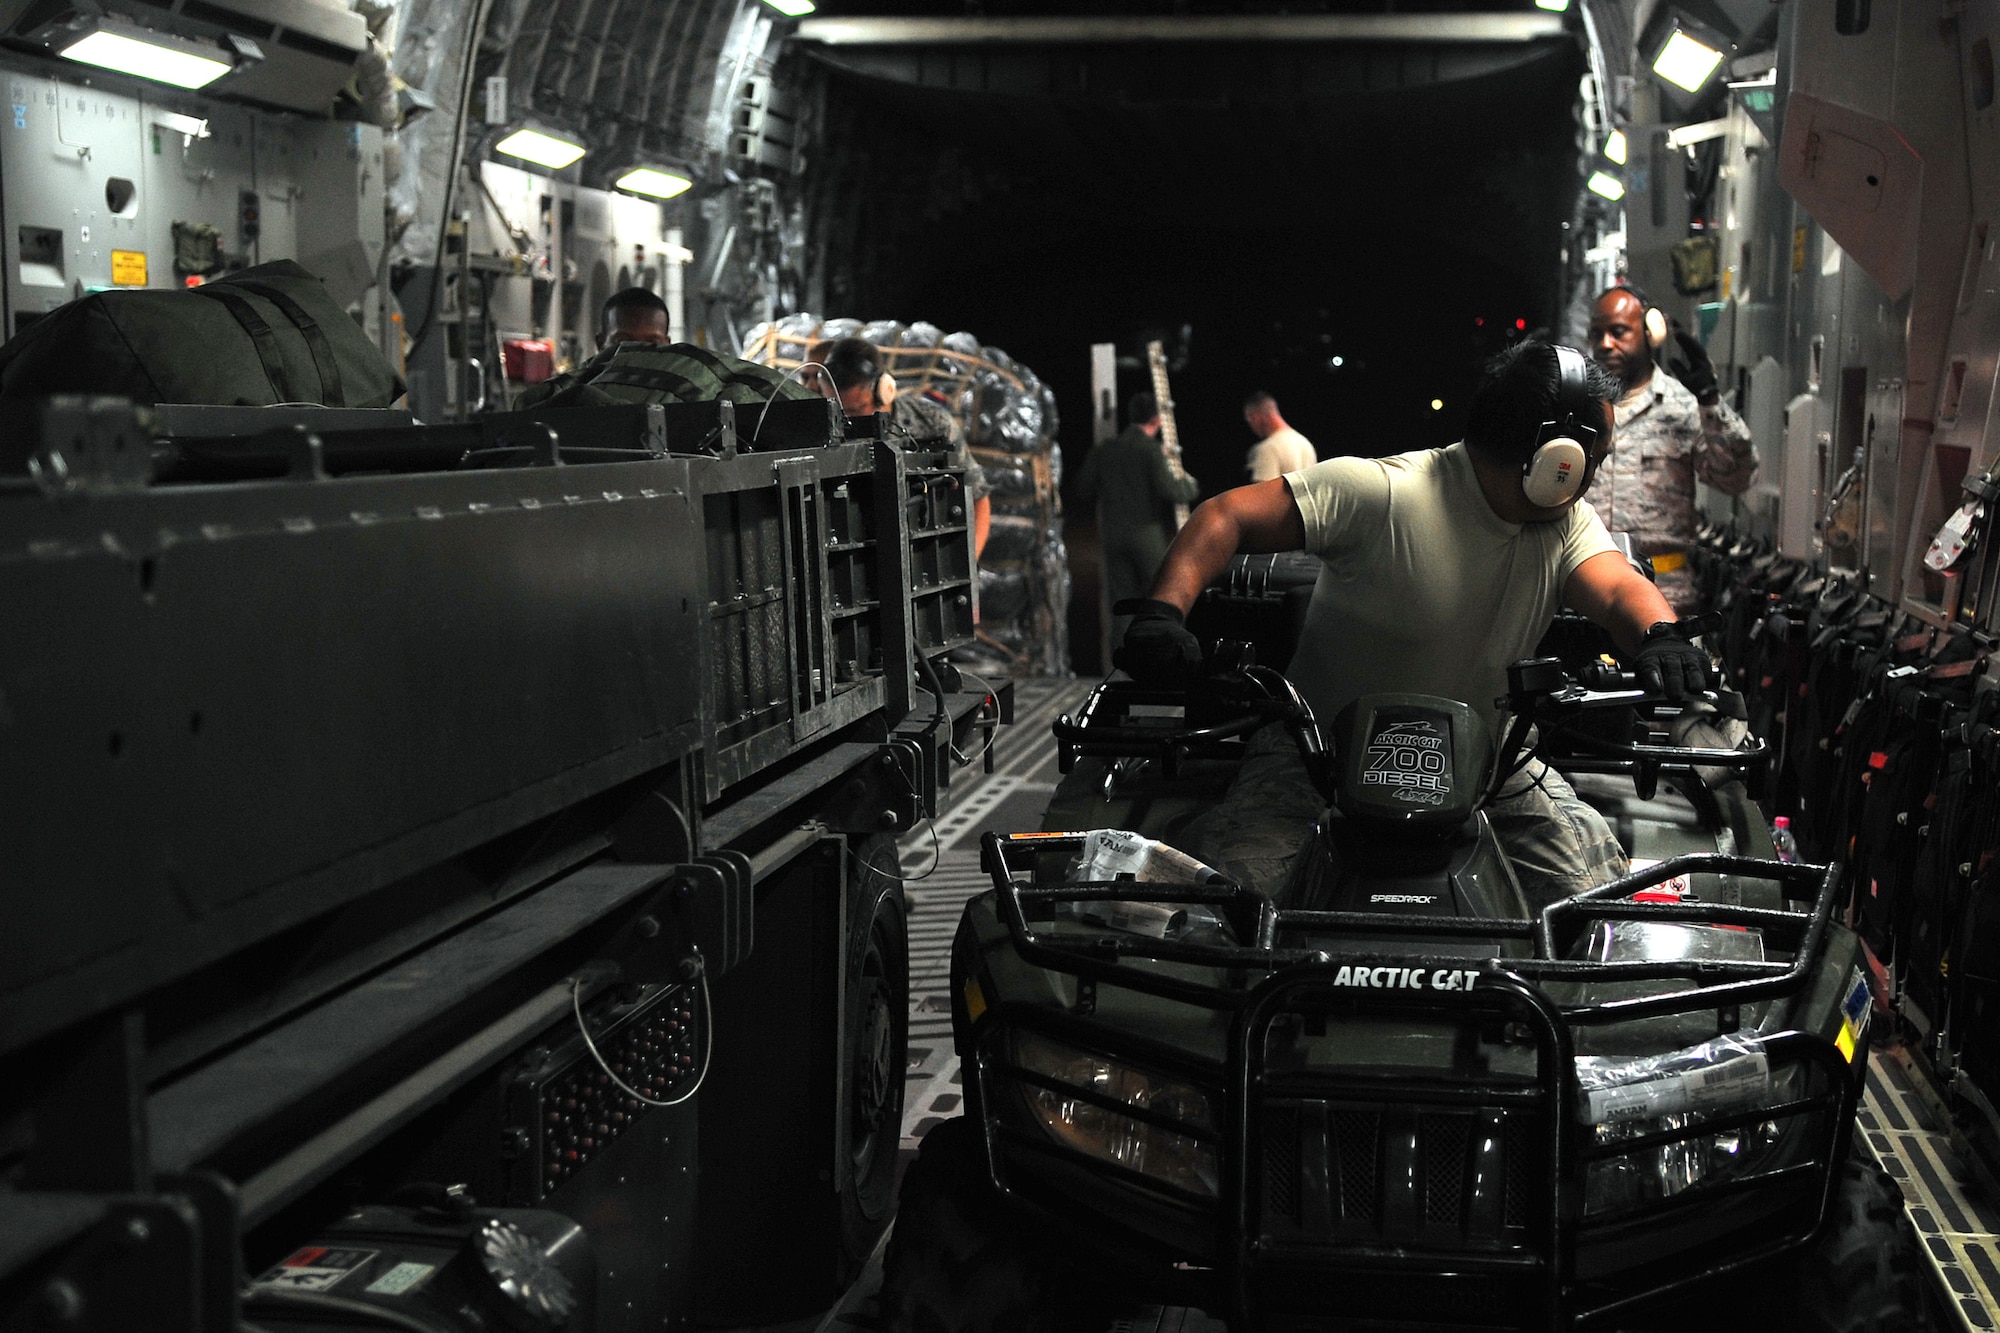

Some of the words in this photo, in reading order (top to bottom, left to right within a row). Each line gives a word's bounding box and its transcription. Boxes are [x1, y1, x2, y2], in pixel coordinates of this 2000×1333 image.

[1374, 733, 1418, 746] ARCTIC
[1418, 736, 1442, 749] CAT
[1368, 746, 1446, 775] 700
[1363, 771, 1450, 793] DIESEL
[1333, 966, 1426, 990] ARCTIC
[1431, 969, 1481, 992] CAT
